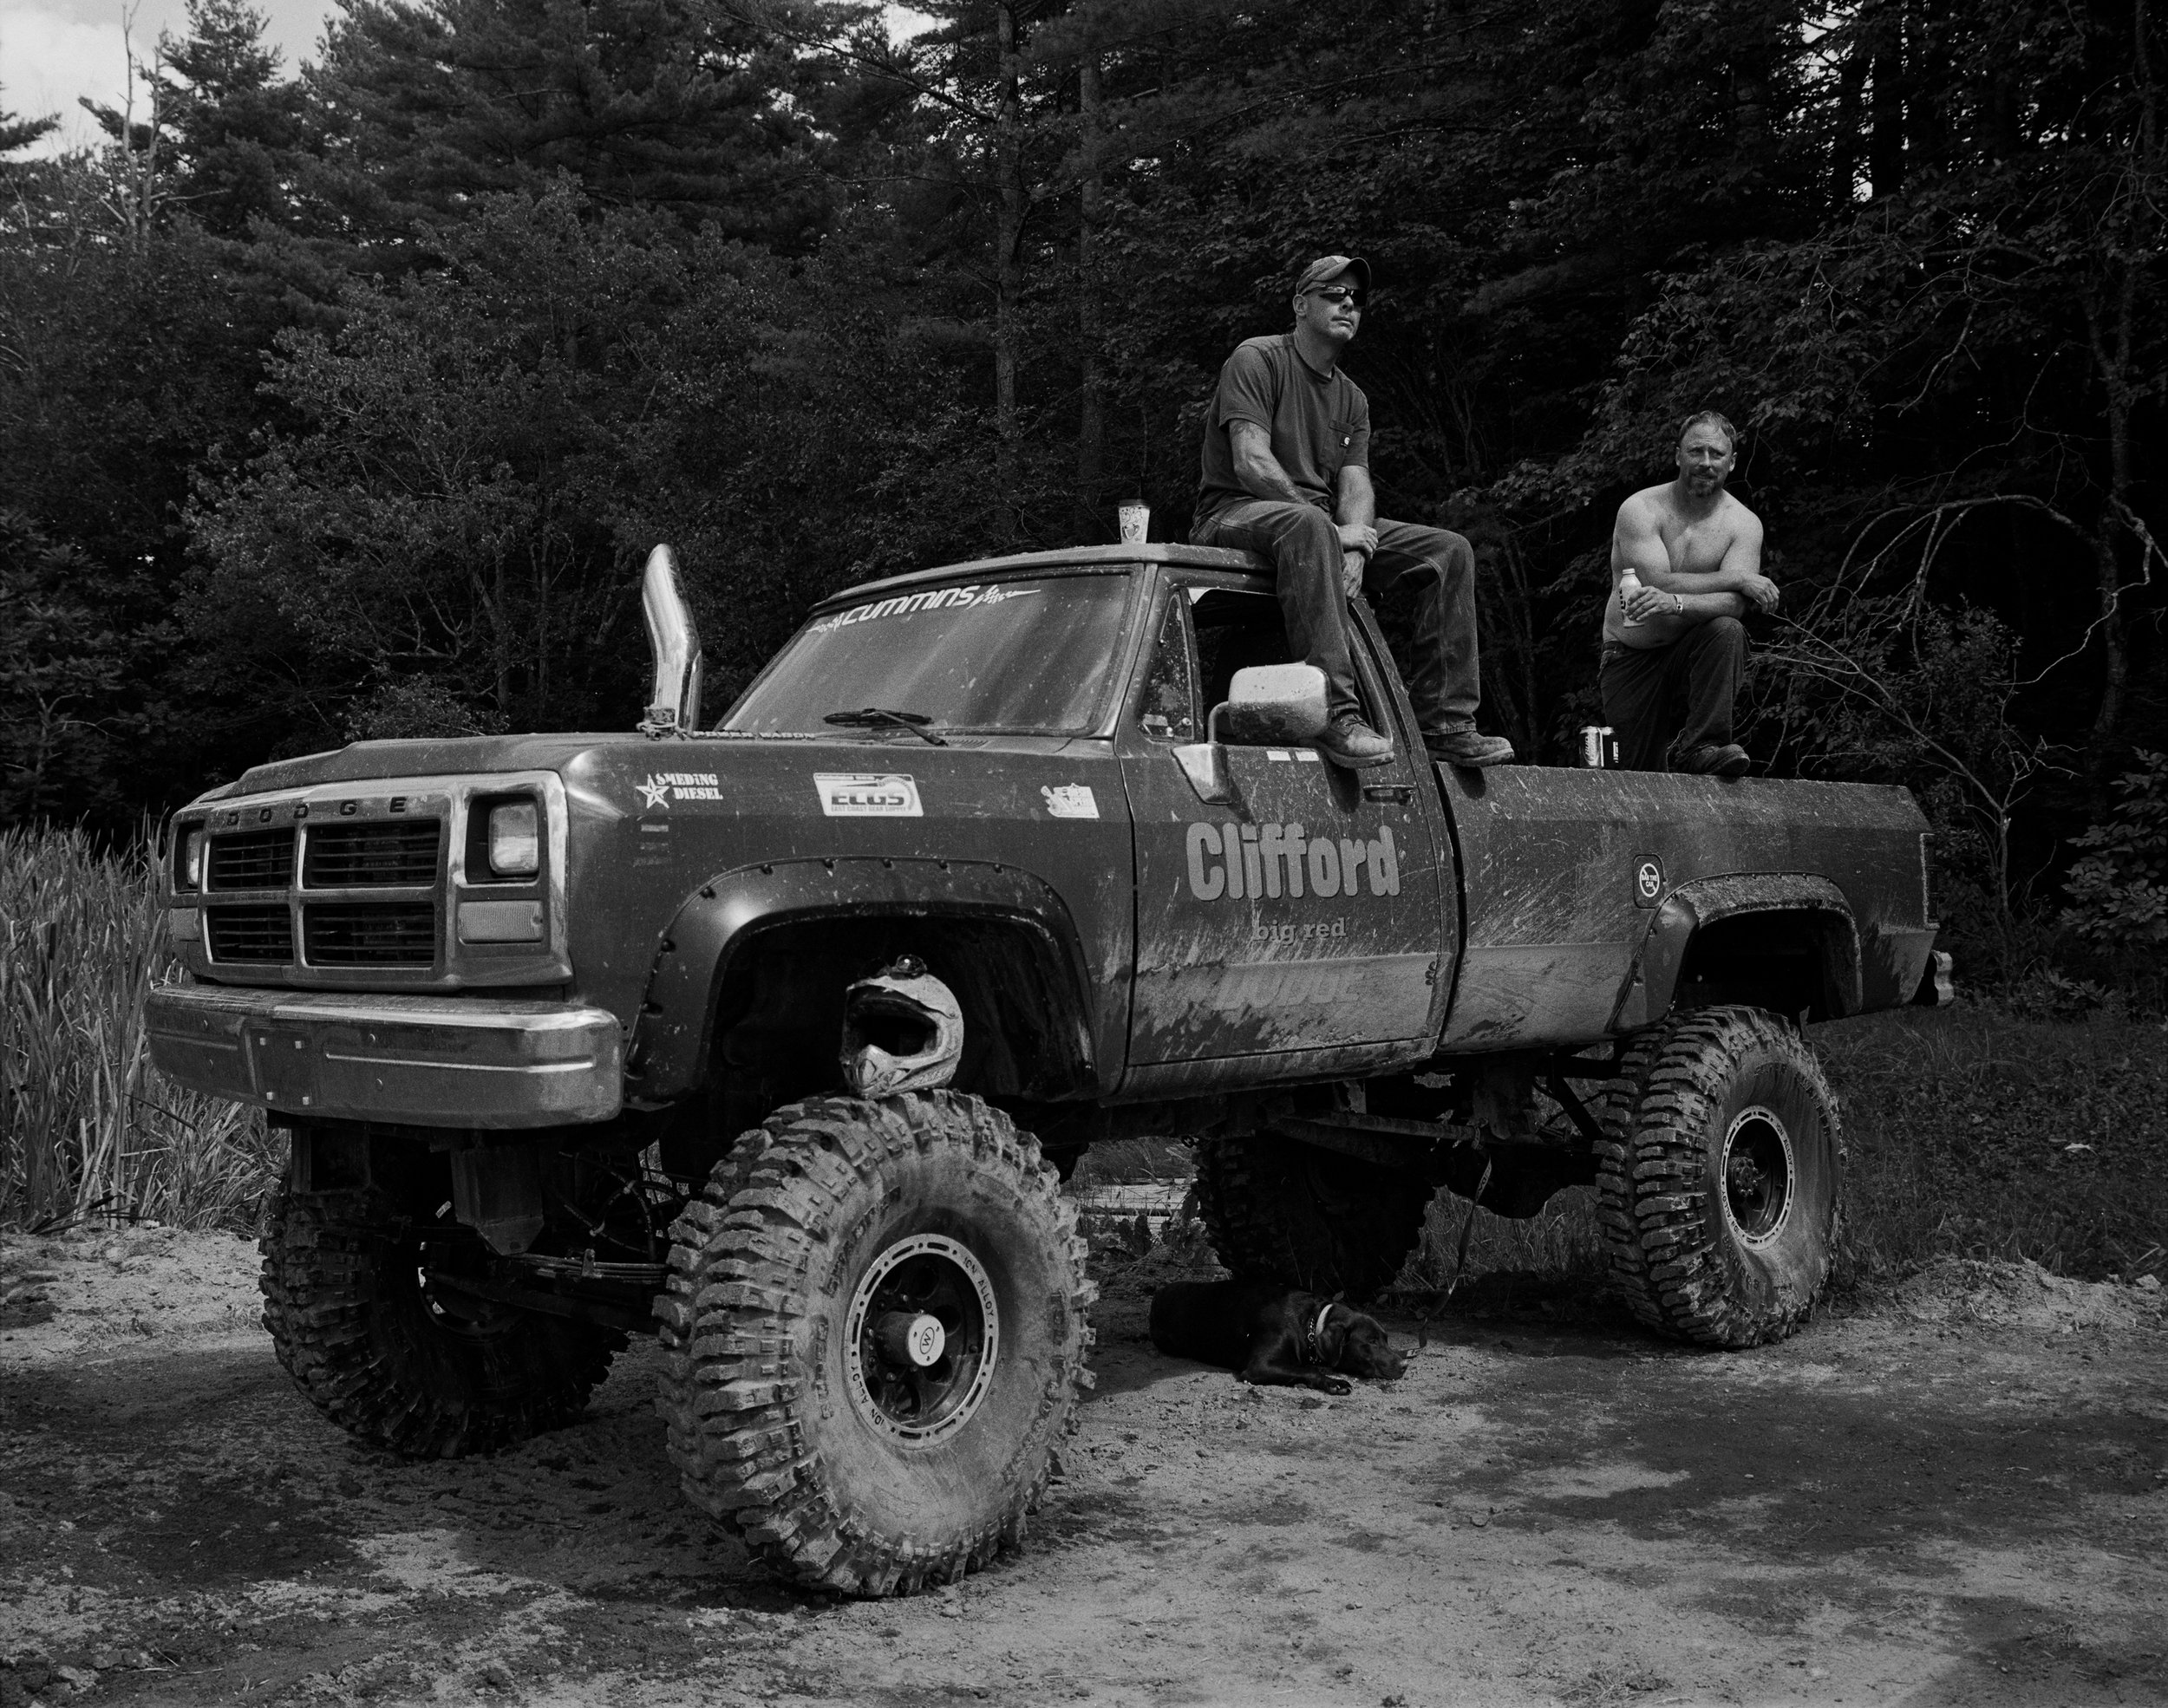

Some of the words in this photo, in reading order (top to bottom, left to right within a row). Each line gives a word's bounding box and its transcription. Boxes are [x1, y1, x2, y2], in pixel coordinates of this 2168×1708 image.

[673, 787, 724, 800] DIESEL
[831, 789, 905, 806] ECGS
[227, 796, 408, 826] DODGE
[1186, 822, 1401, 902] Clifford
[1251, 920, 1296, 945] big
[1303, 917, 1348, 939] red
[963, 1255, 978, 1274] ION
[978, 1279, 995, 1317] ALLOY
[850, 1366, 869, 1405] ALLOY
